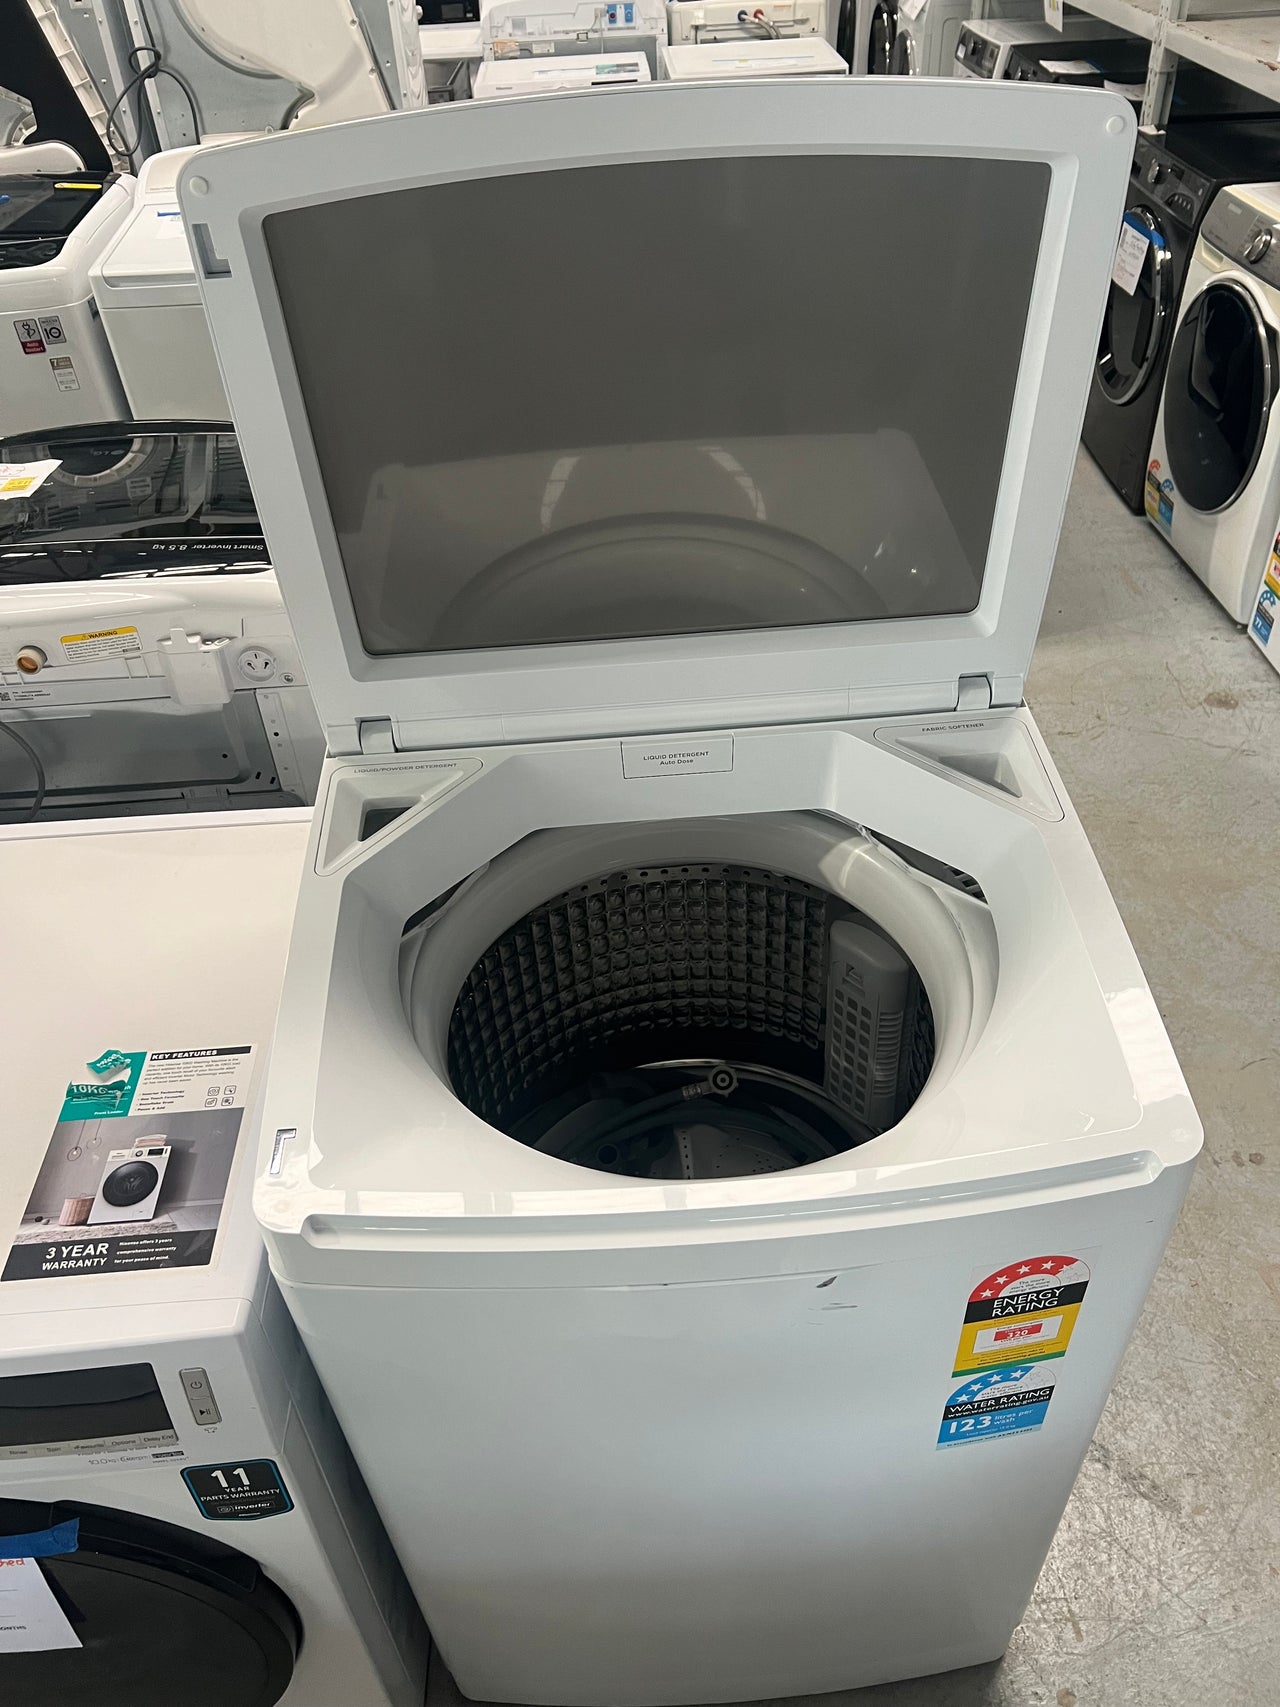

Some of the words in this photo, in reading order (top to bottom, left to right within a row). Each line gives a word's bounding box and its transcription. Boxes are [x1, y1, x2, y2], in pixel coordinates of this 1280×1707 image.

[87, 630, 118, 640] WARNING
[668, 751, 709, 759] DETERGENT
[151, 1053, 171, 1061] KEY
[172, 1049, 218, 1059] FEATURES
[45, 1247, 57, 1260] 3
[61, 1242, 109, 1259] YEAR
[42, 1257, 107, 1271] WARRANTY
[993, 1287, 1064, 1308] ENERGY
[991, 1297, 1058, 1317] RATING
[1006, 1329, 1028, 1340] 320
[947, 1394, 1050, 1418] www.waterrating.gov.au
[949, 1400, 996, 1413] WATER
[999, 1388, 1050, 1404] RATING
[949, 1415, 992, 1434] 123
[994, 1412, 1016, 1421] litres
[1018, 1409, 1033, 1417] per
[993, 1417, 1016, 1425] wash
[111, 1439, 136, 1447] Options
[210, 1467, 251, 1488] 11
[200, 1493, 230, 1502] PARTS
[230, 1488, 280, 1499] WARRANTY
[224, 1485, 250, 1493] YEAR
[234, 1502, 271, 1511] inverter
